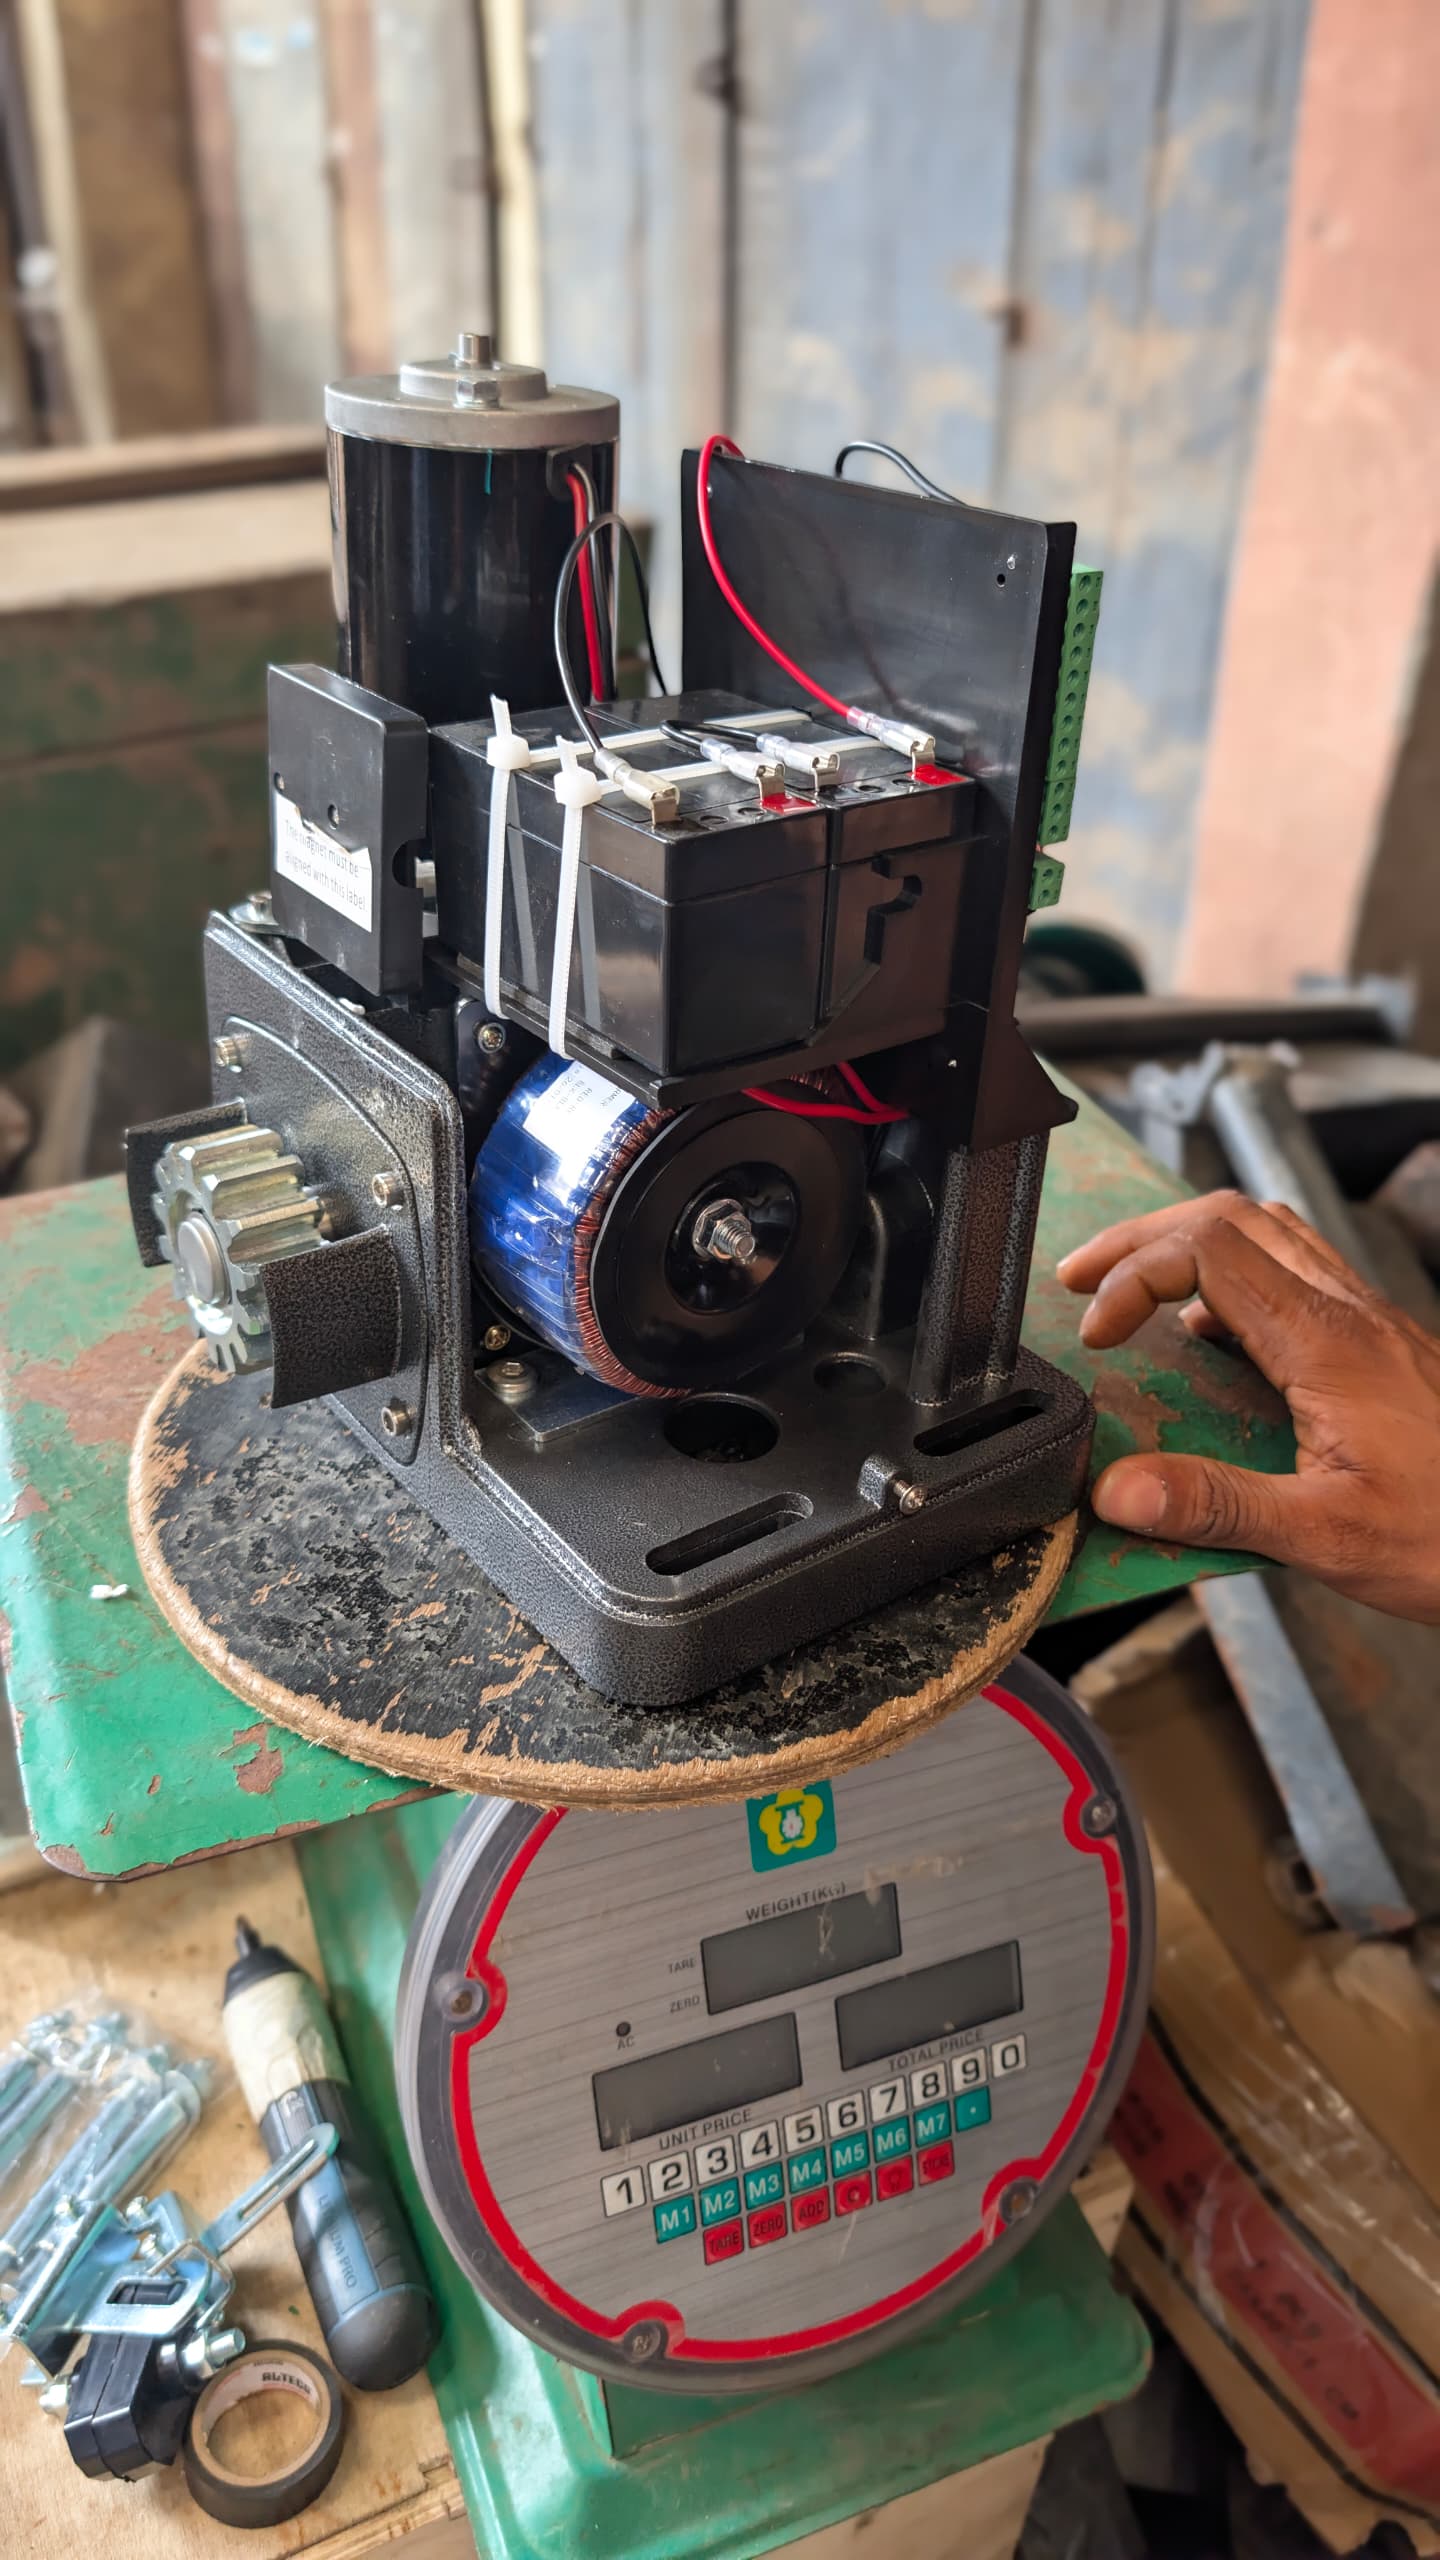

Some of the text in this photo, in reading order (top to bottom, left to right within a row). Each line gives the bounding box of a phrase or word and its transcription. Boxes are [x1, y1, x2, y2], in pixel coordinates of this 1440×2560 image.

[329, 848, 347, 869] must
[312, 869, 330, 888] with
[330, 876, 345, 898] this
[668, 1957, 695, 1974] TARE
[670, 1995, 700, 2013] ZERO
[617, 2036, 634, 2051] AC
[888, 2028, 984, 2072] TOTAL PRICE
[616, 2044, 1020, 2205] 1 2 3 4 5 6 7 8 9 0
[659, 2109, 752, 2150] UNIT PRICE
[660, 2112, 946, 2232] M1 M2 M3 M4 M5 M6 M7
[709, 2231, 739, 2252] TARE
[753, 2215, 783, 2237] ZERO
[799, 2199, 825, 2219] ADD
[339, 2256, 358, 2289] PRO
